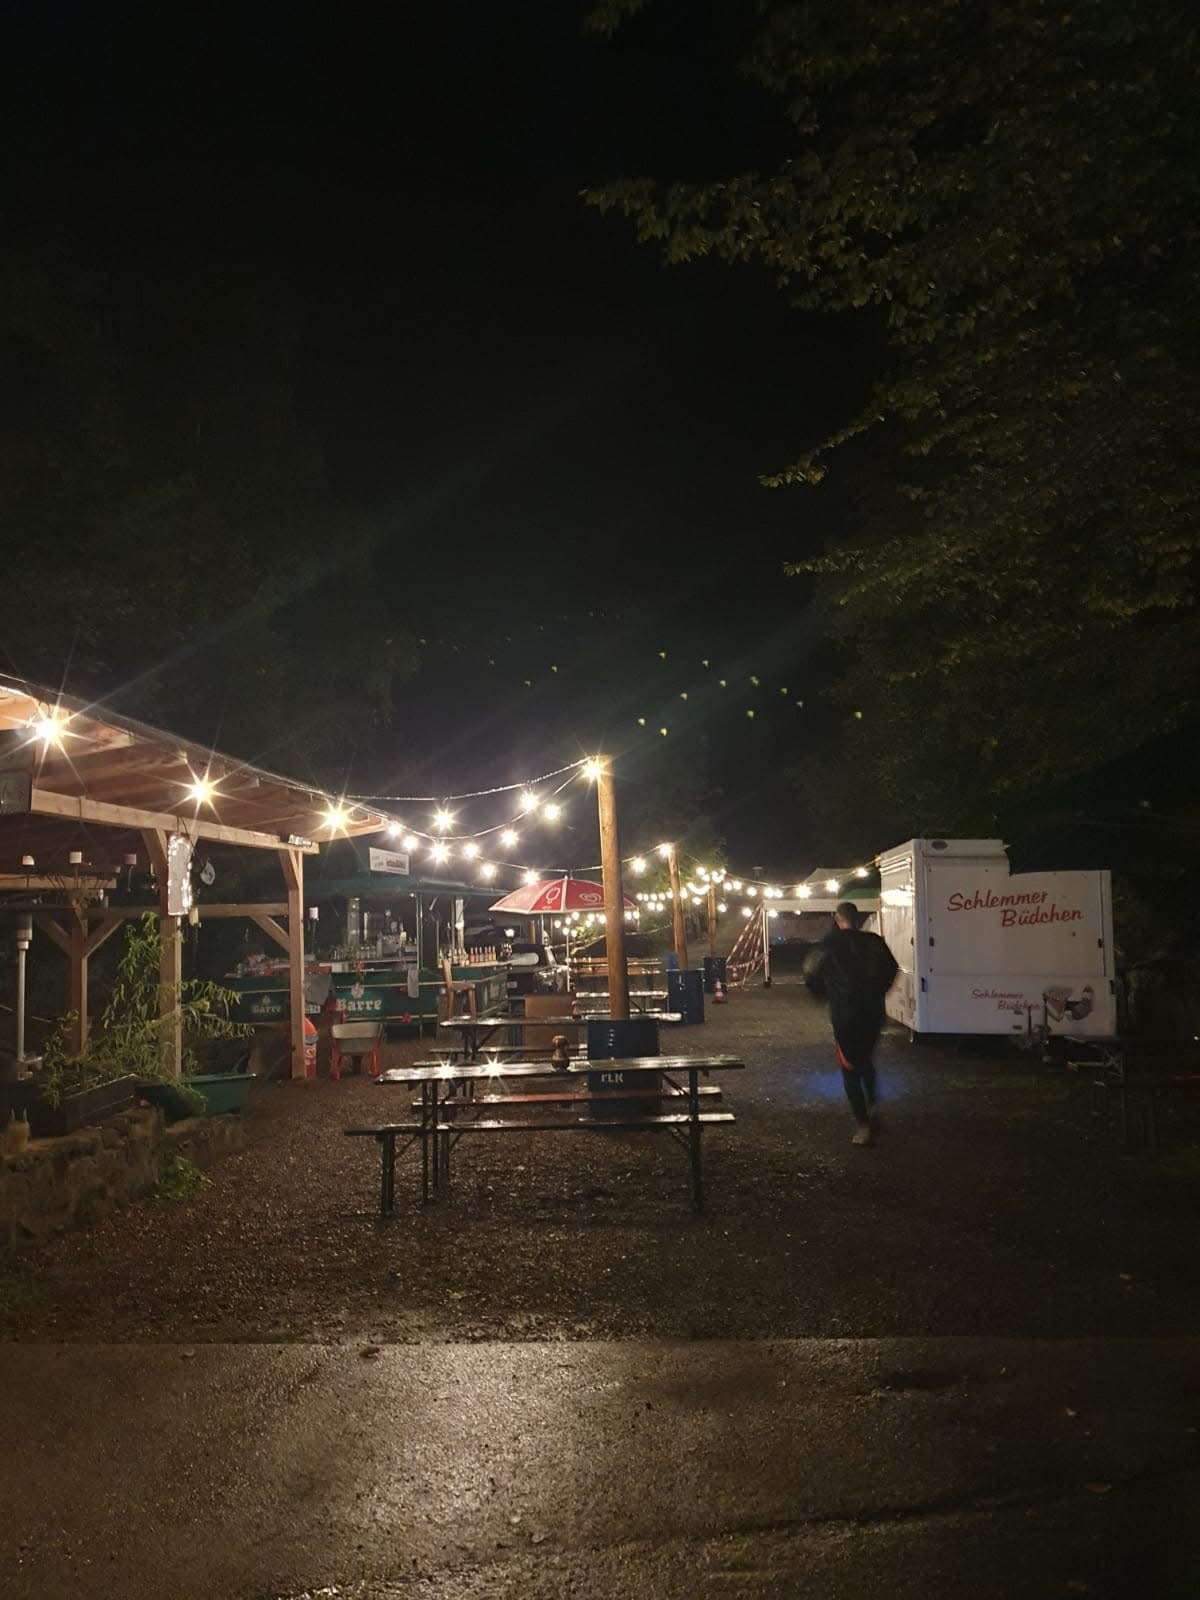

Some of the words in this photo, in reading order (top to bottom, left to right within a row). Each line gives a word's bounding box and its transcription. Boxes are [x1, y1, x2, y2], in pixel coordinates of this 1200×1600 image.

[947, 890, 1048, 911] Schlemmer
[1001, 904, 1083, 927] Büdchen
[335, 998, 383, 1011] Barre
